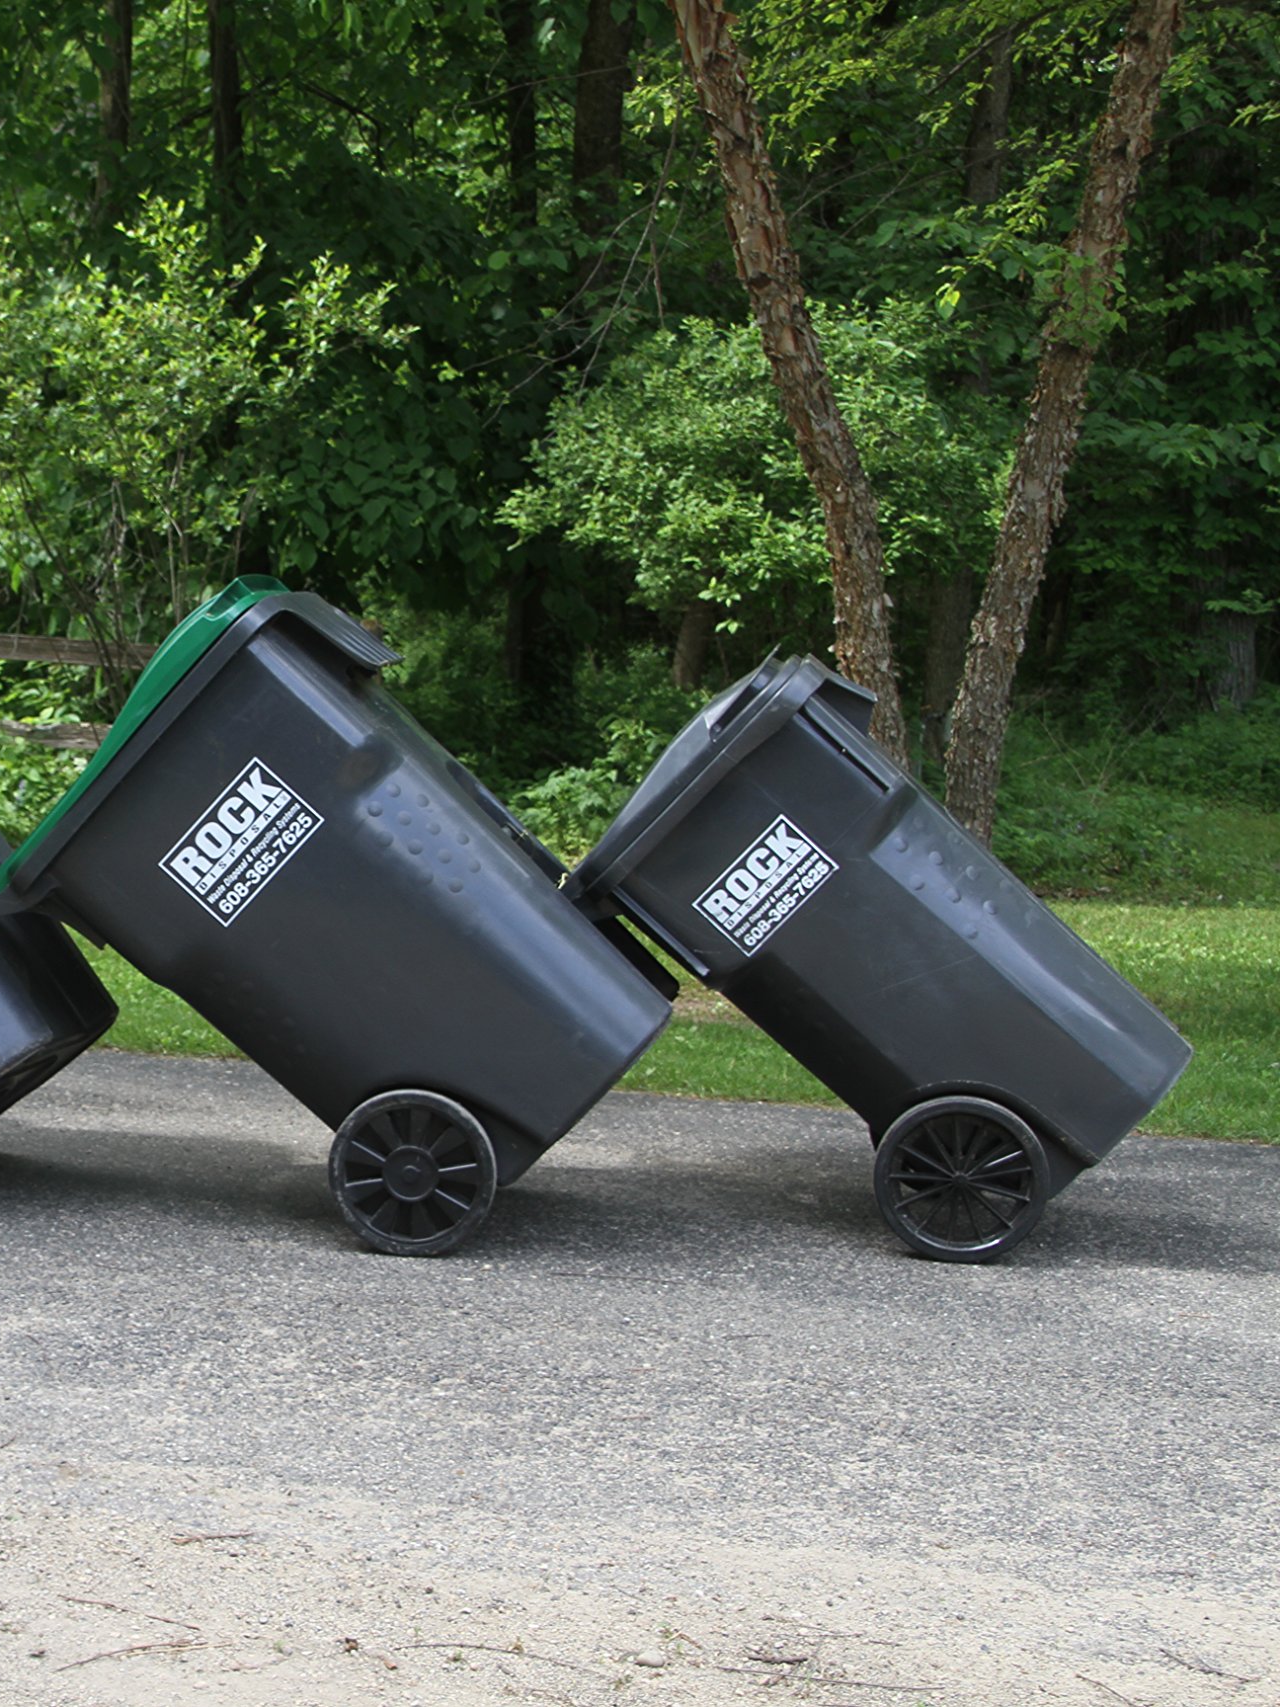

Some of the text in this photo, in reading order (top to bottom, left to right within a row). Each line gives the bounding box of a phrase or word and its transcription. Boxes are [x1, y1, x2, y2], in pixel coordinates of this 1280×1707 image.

[169, 767, 282, 887] ROCK
[198, 802, 281, 890] DISPOSAL
[218, 812, 313, 914] 608-365-7625
[222, 859, 250, 887] Disposal
[251, 827, 280, 857] Recycling
[275, 802, 301, 830] Systems
[701, 823, 804, 923] ROCK
[726, 852, 802, 926] DISPOSAL
[743, 861, 829, 946] 608-365-7625
